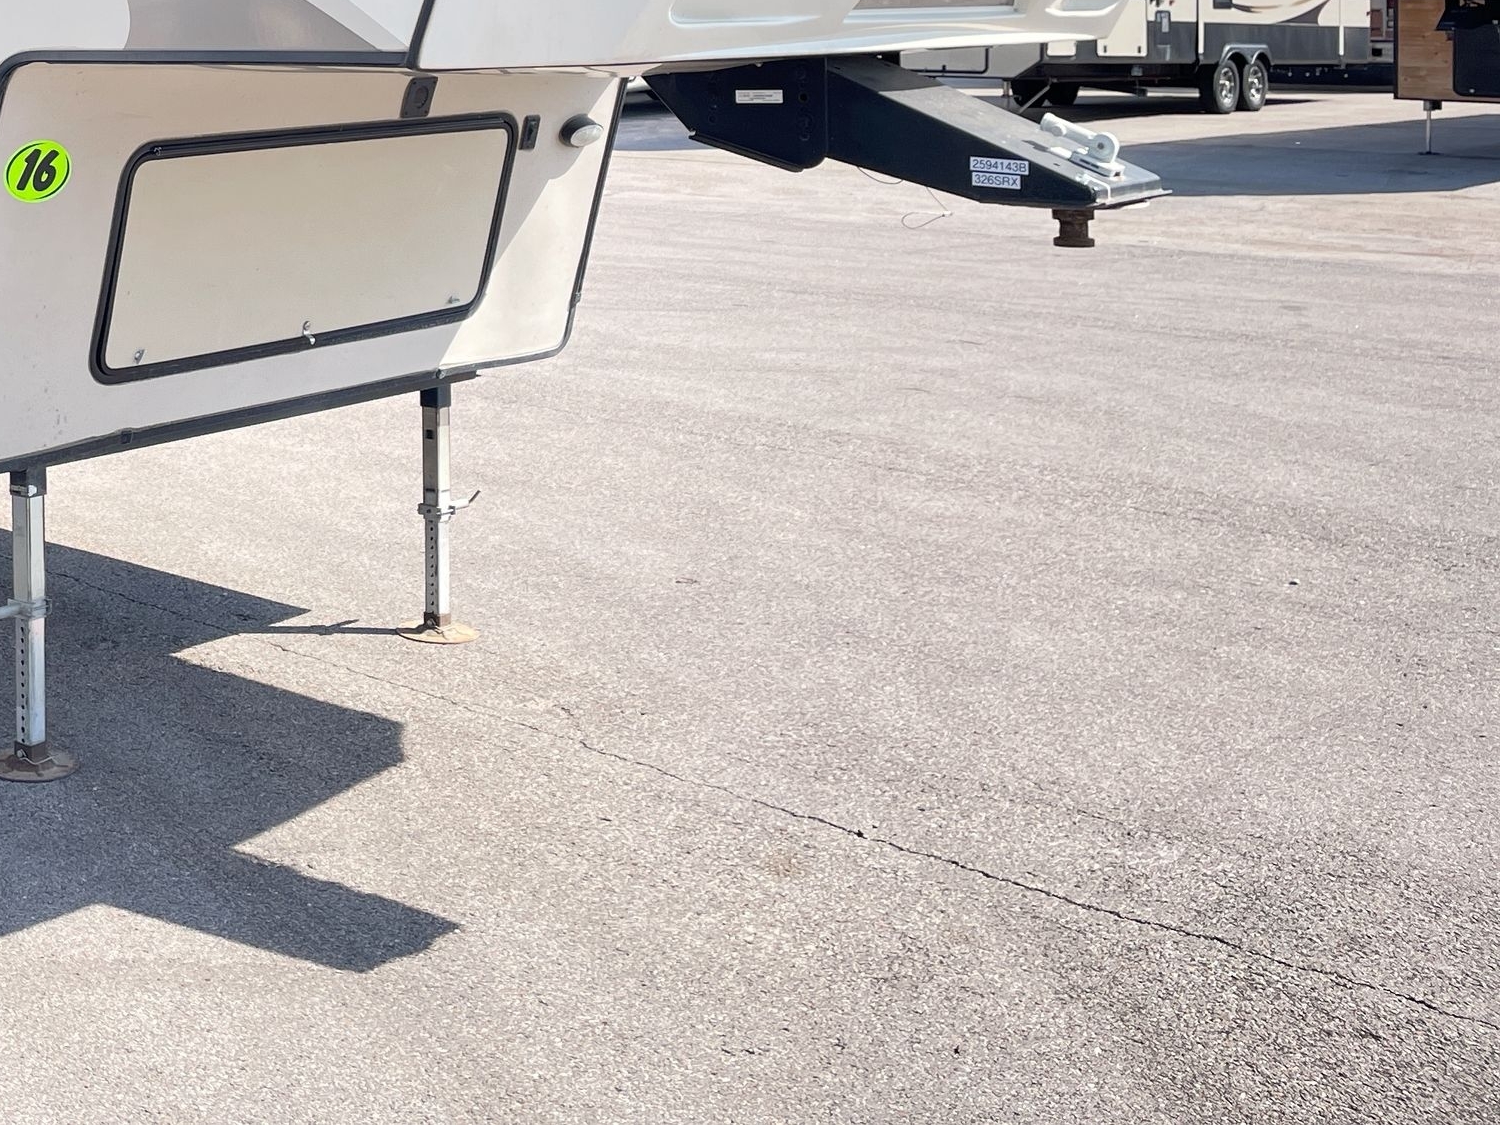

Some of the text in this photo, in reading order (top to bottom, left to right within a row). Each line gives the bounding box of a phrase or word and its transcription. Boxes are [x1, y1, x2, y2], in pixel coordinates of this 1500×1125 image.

[16, 148, 60, 192] 16
[972, 159, 1027, 172] 2594143B
[974, 173, 1019, 187] 326SRX
